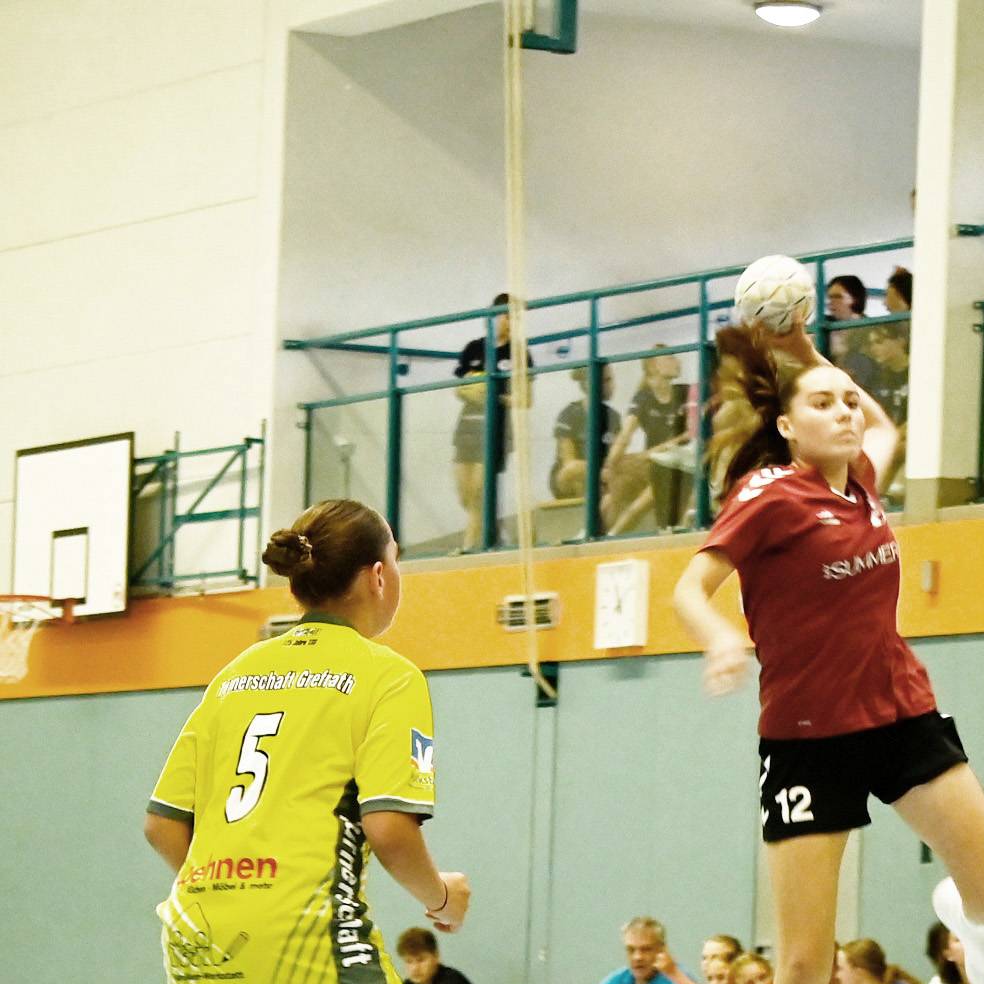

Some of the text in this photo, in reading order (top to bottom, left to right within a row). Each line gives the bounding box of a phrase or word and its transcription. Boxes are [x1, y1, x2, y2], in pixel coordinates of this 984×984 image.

[295, 669, 355, 695] Grefrath
[223, 711, 285, 824] 5
[774, 785, 815, 824] 12
